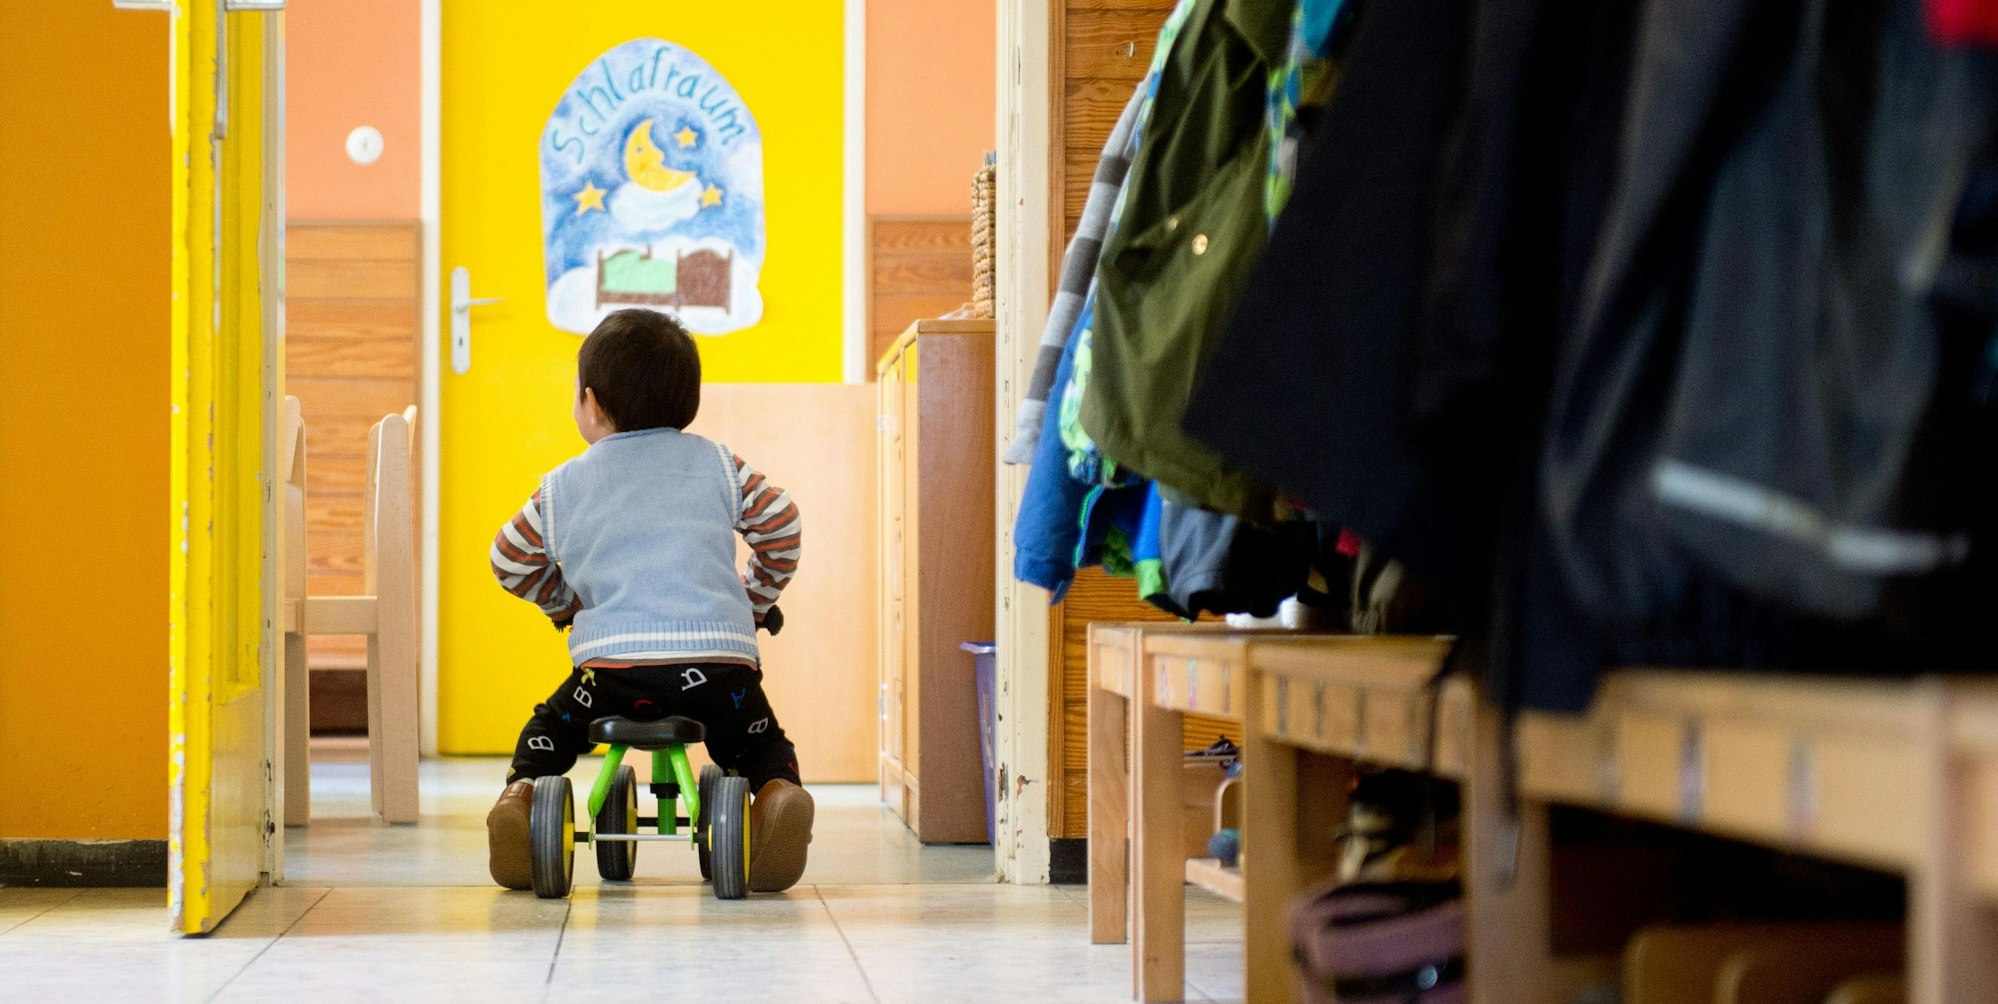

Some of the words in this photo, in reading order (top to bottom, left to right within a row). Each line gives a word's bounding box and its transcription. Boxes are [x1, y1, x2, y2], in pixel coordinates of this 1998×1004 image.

[552, 46, 747, 165] Schlafraum
[573, 686, 593, 708] B
[747, 717, 768, 734] B
[527, 735, 554, 751] B
